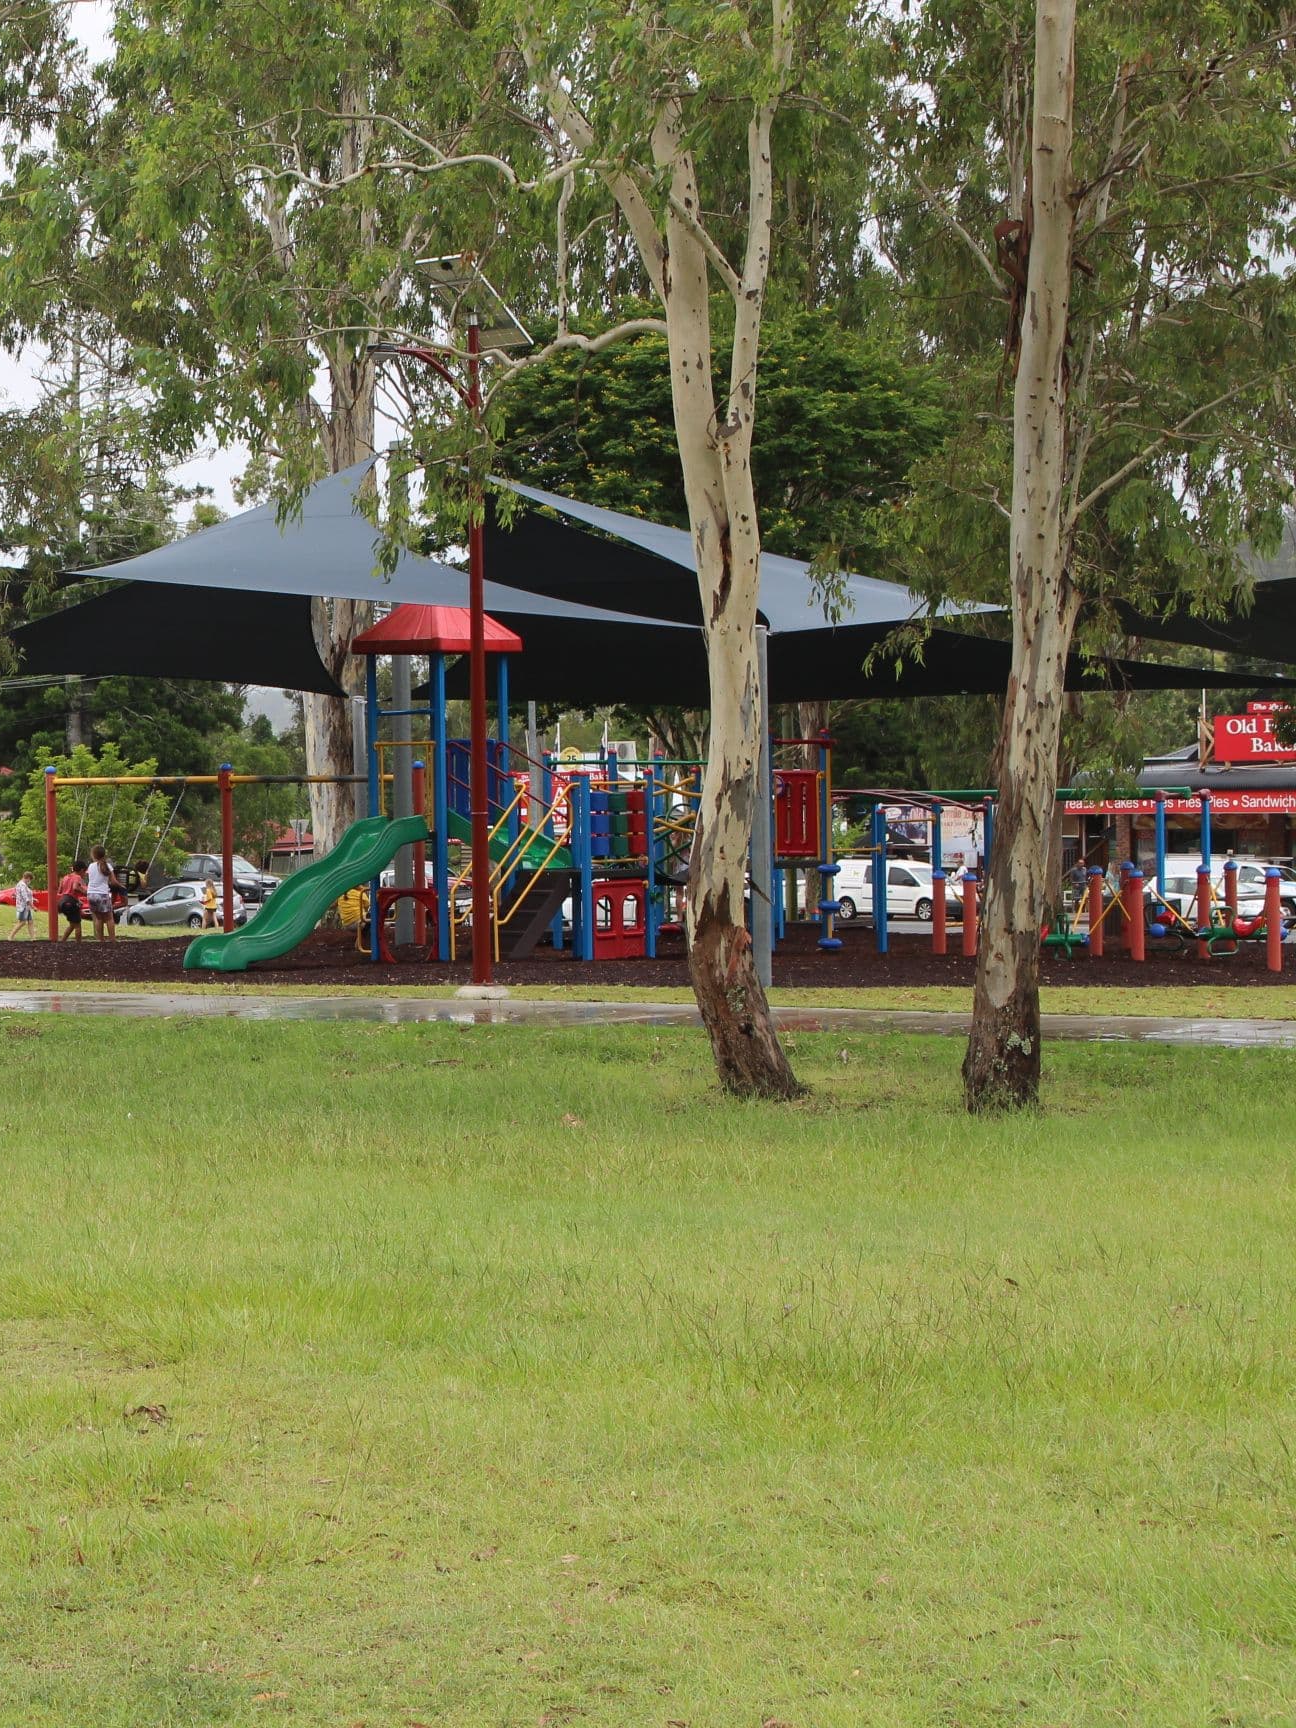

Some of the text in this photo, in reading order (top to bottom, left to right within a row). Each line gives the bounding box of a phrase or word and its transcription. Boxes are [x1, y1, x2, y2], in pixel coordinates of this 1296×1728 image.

[1226, 718, 1258, 734] Old
[1105, 798, 1139, 809] Cakes
[1150, 798, 1174, 809] Pes
[1177, 797, 1202, 808] Pies
[1241, 794, 1296, 808] Sandwich
